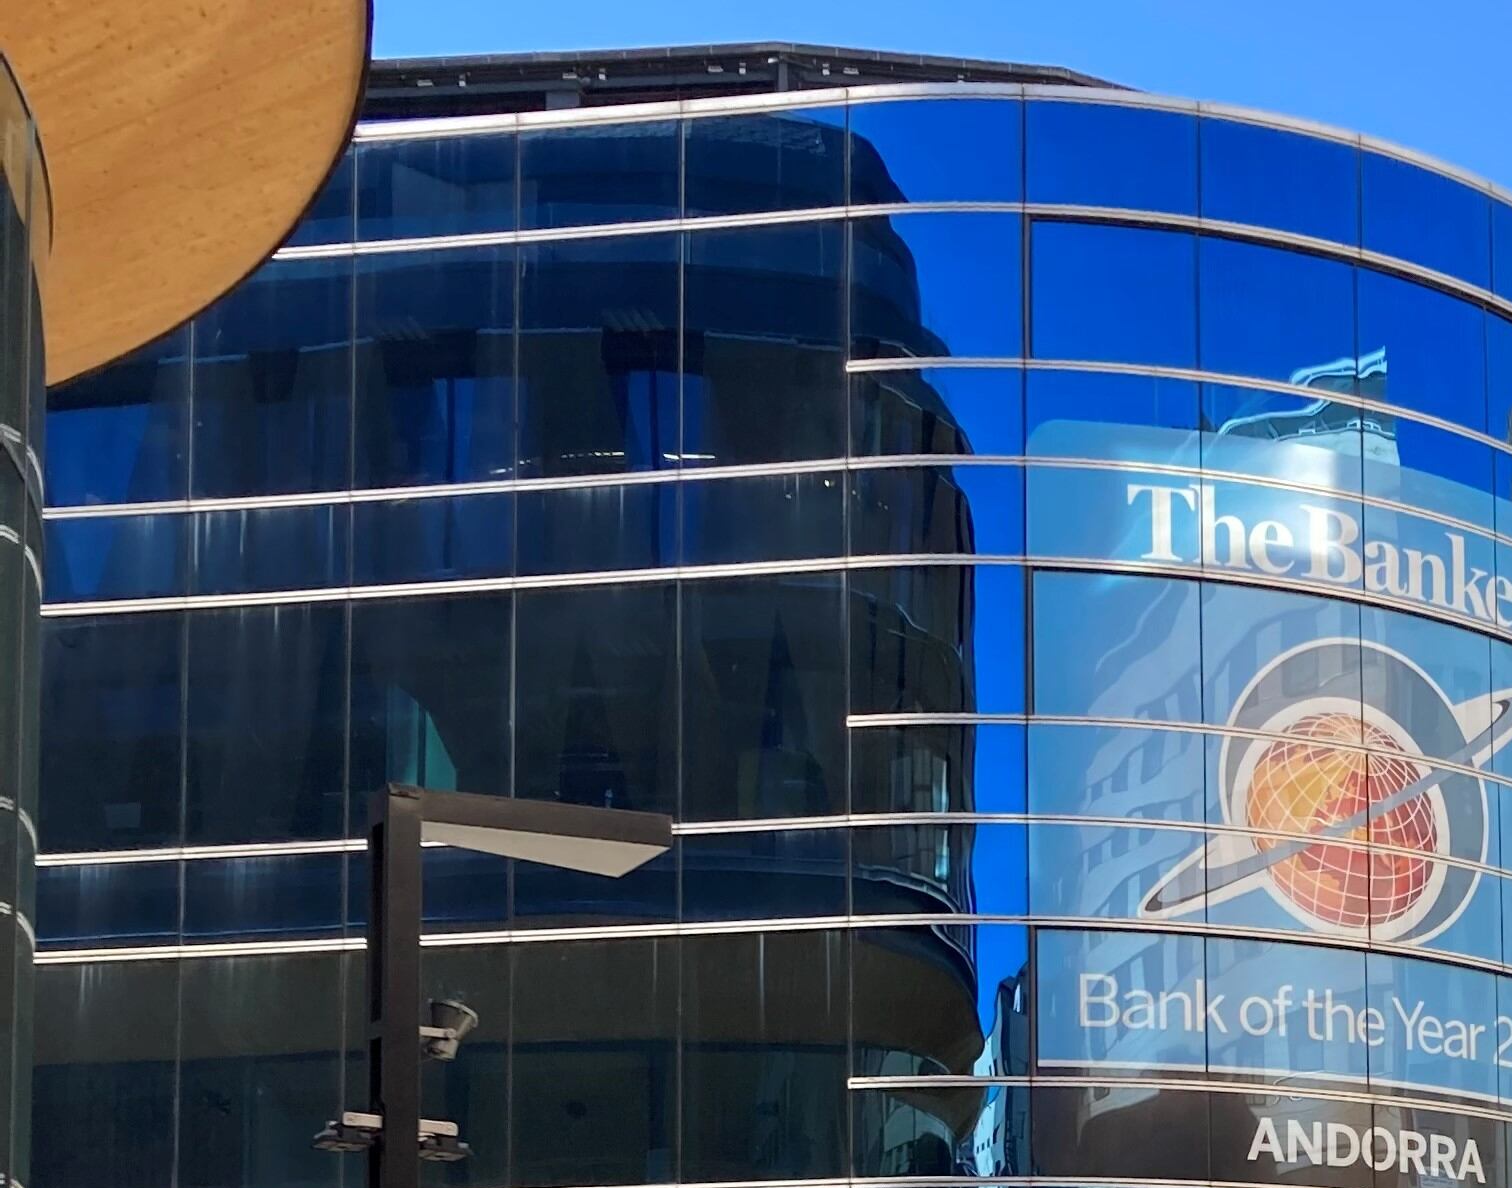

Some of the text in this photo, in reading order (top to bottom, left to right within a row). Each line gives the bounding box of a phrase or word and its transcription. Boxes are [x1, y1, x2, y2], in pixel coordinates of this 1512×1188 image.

[1127, 484, 1291, 569] The
[1079, 973, 1227, 1034] Bank
[1239, 984, 1293, 1037] of
[1303, 991, 1385, 1047] the
[1390, 995, 1480, 1068] Year
[1247, 1116, 1487, 1184] ANDORRA
